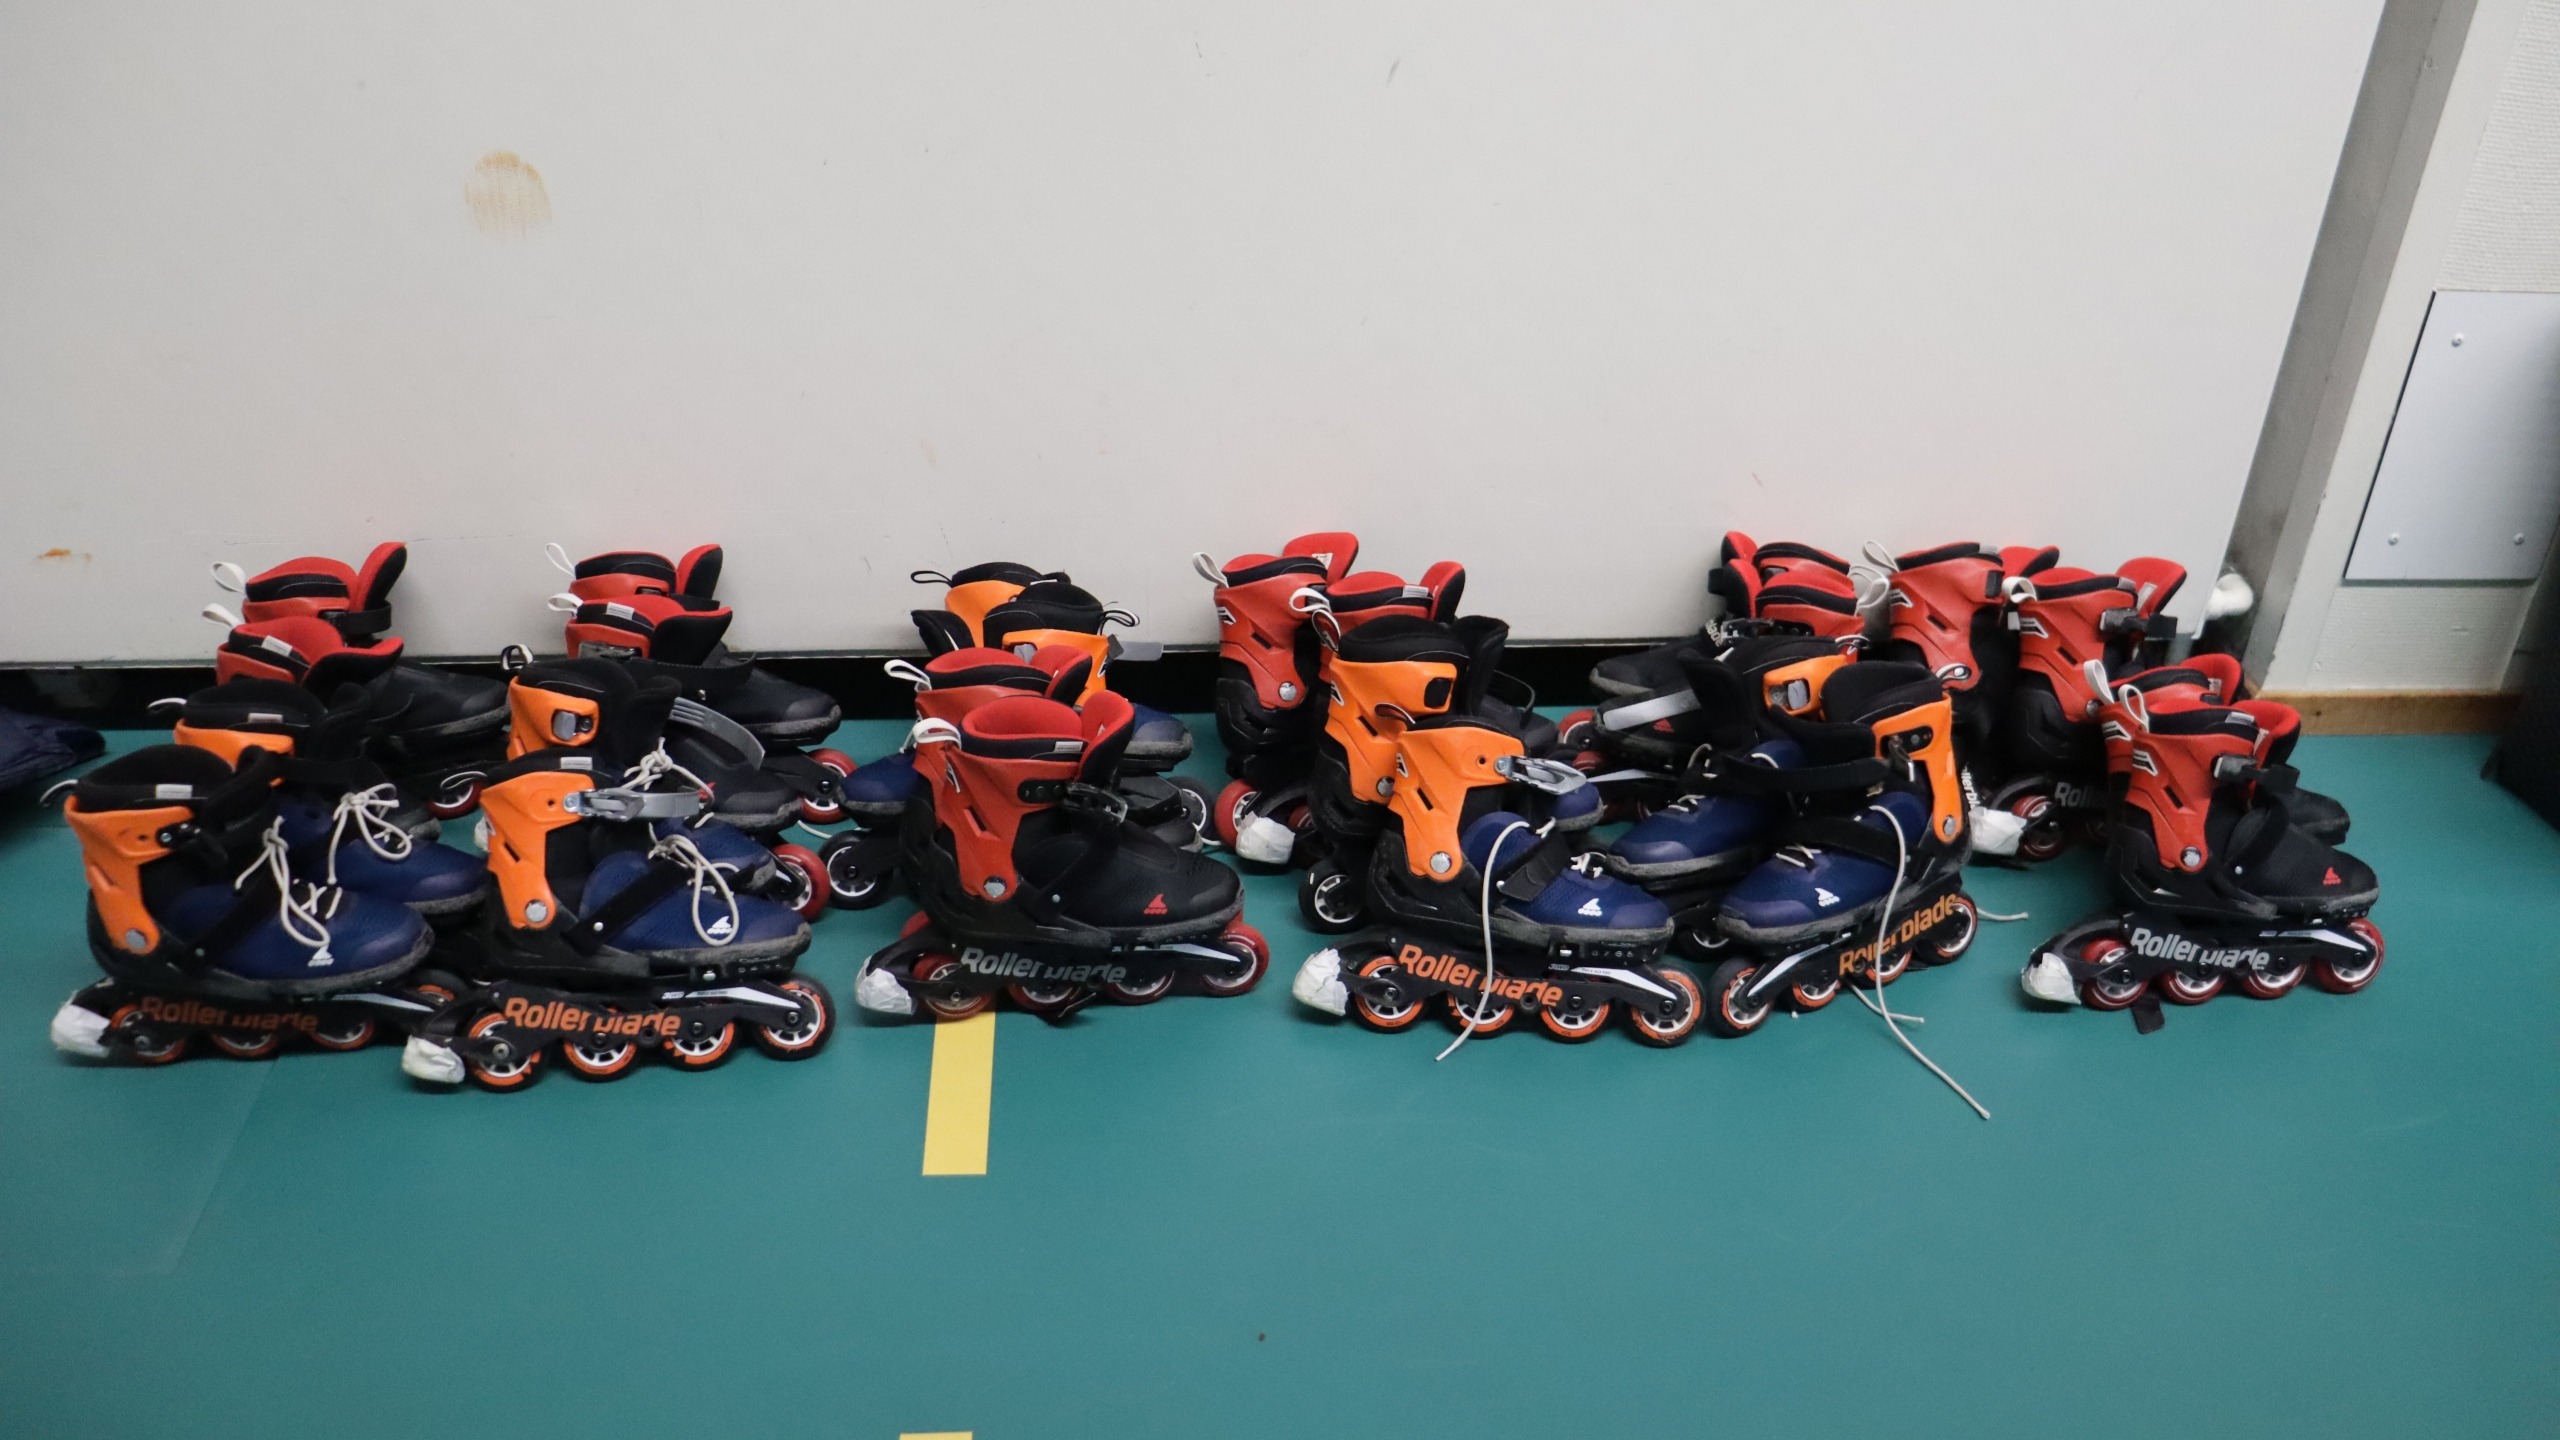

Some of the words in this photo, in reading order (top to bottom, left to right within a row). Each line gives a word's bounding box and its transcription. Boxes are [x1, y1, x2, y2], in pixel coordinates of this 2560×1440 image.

[960, 947, 1127, 984] Rollerblade
[2130, 927, 2270, 970] Rollerblade
[1399, 944, 1563, 1007] Rollerblade
[505, 997, 681, 1036] Rollerblade
